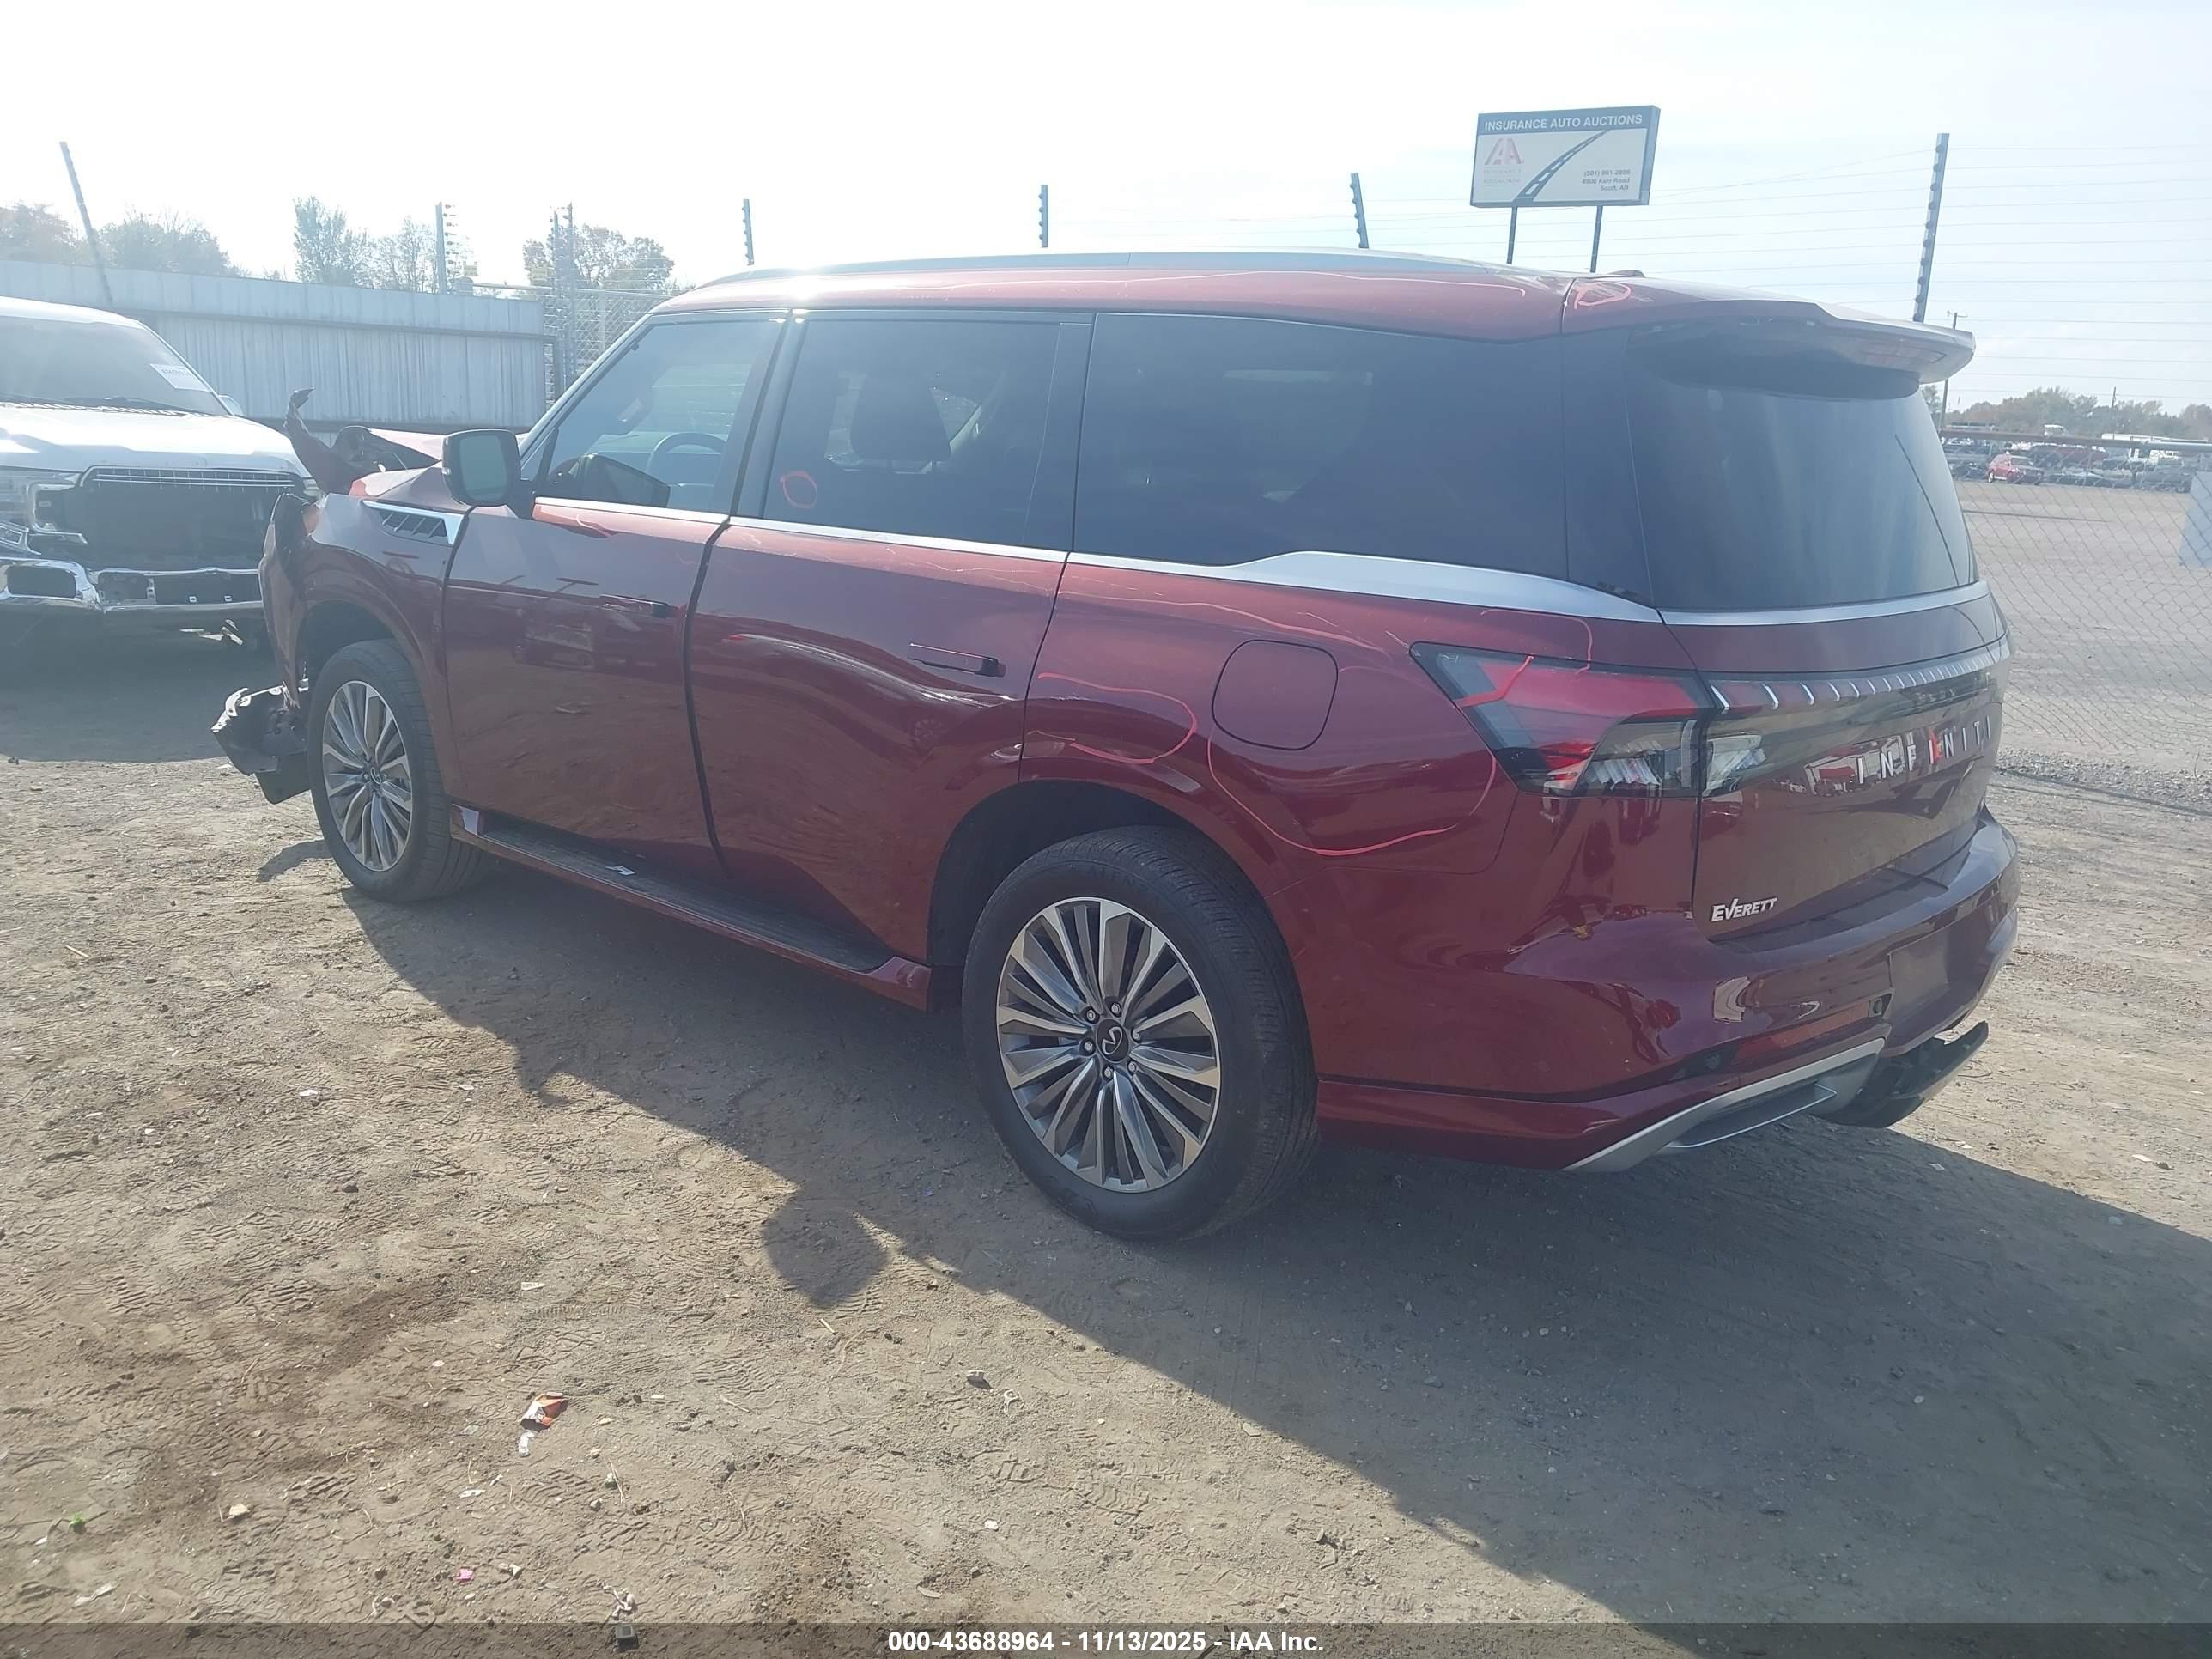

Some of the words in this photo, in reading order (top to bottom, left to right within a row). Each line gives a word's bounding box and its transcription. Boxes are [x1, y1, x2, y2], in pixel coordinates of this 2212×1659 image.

[1485, 118, 1547, 131] INSURANCE
[1550, 117, 1581, 129] AUTO
[1583, 113, 1643, 127] AUCTIONS
[1857, 714, 1991, 784] INFINITI
